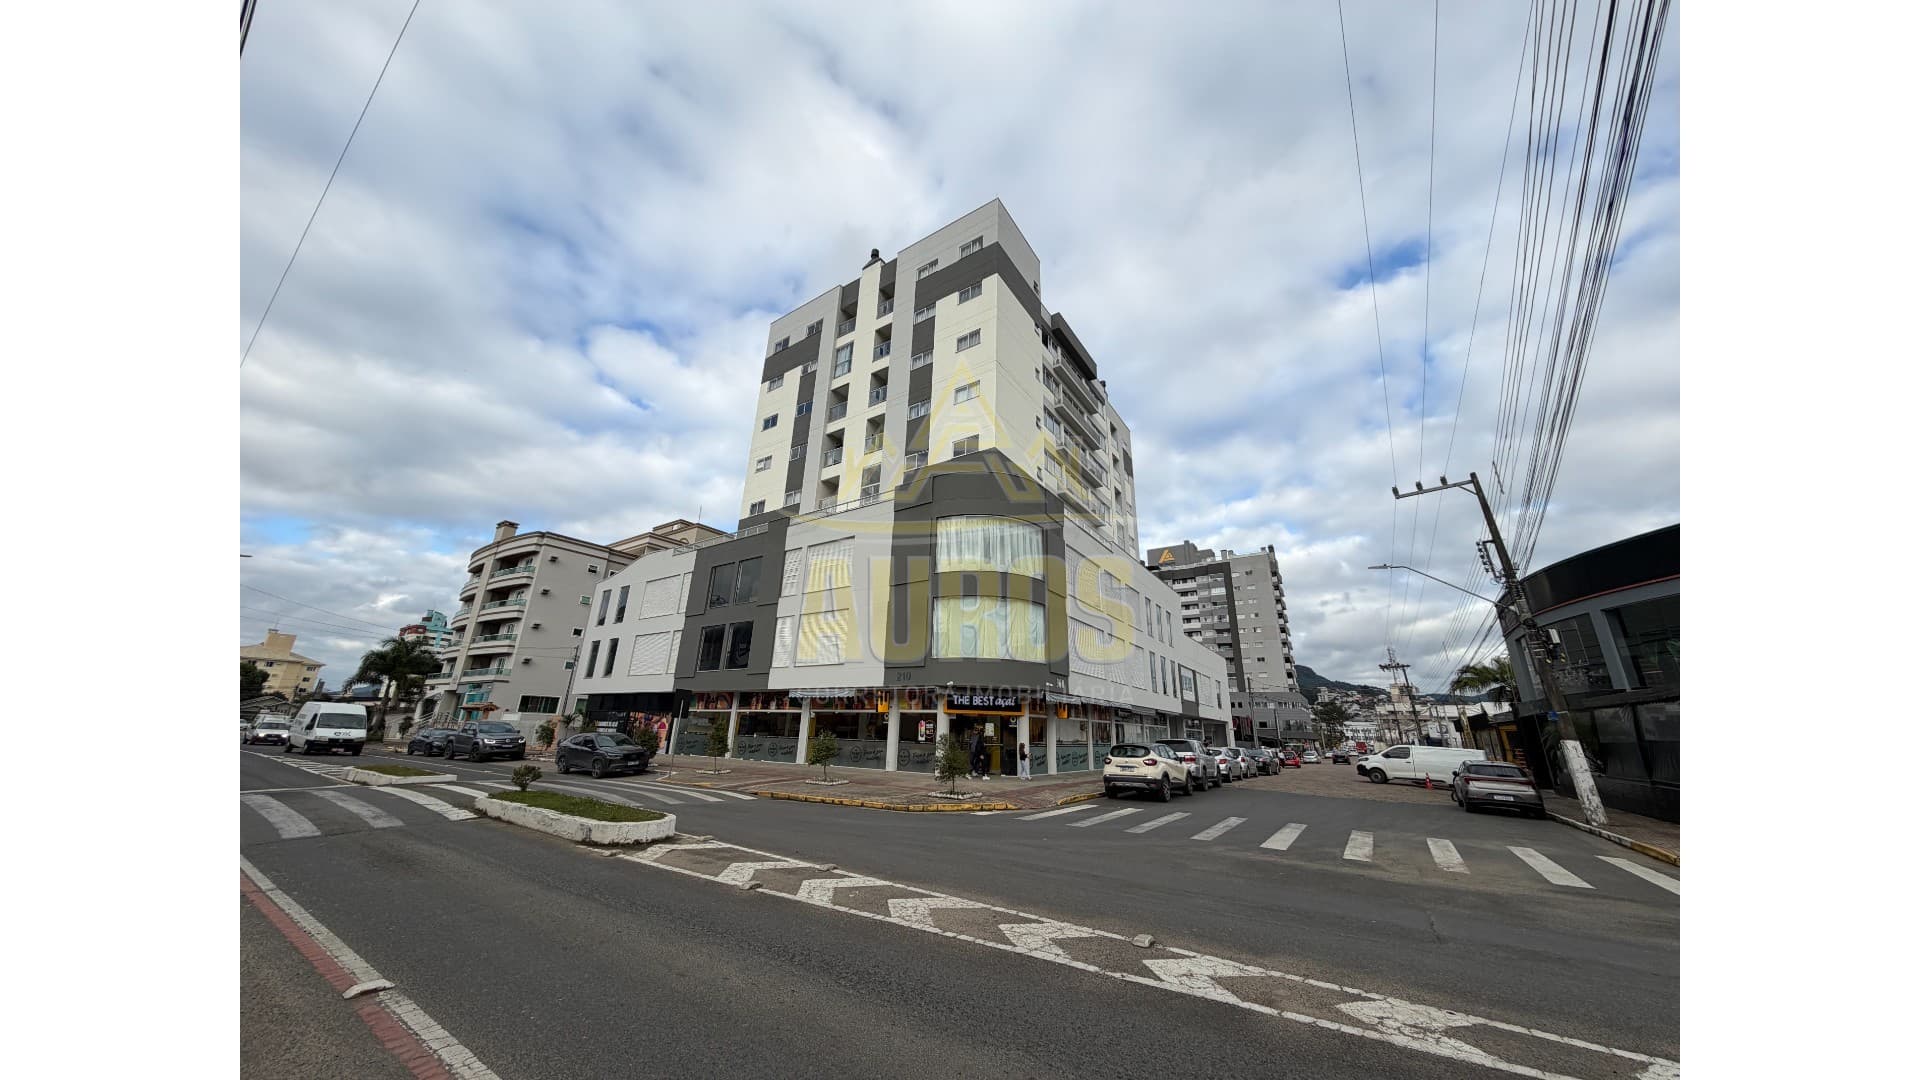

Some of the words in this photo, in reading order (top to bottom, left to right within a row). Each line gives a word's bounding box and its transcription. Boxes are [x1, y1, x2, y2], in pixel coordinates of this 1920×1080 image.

[896, 671, 912, 682] 210
[953, 695, 970, 705] THE
[972, 696, 994, 706] BEST
